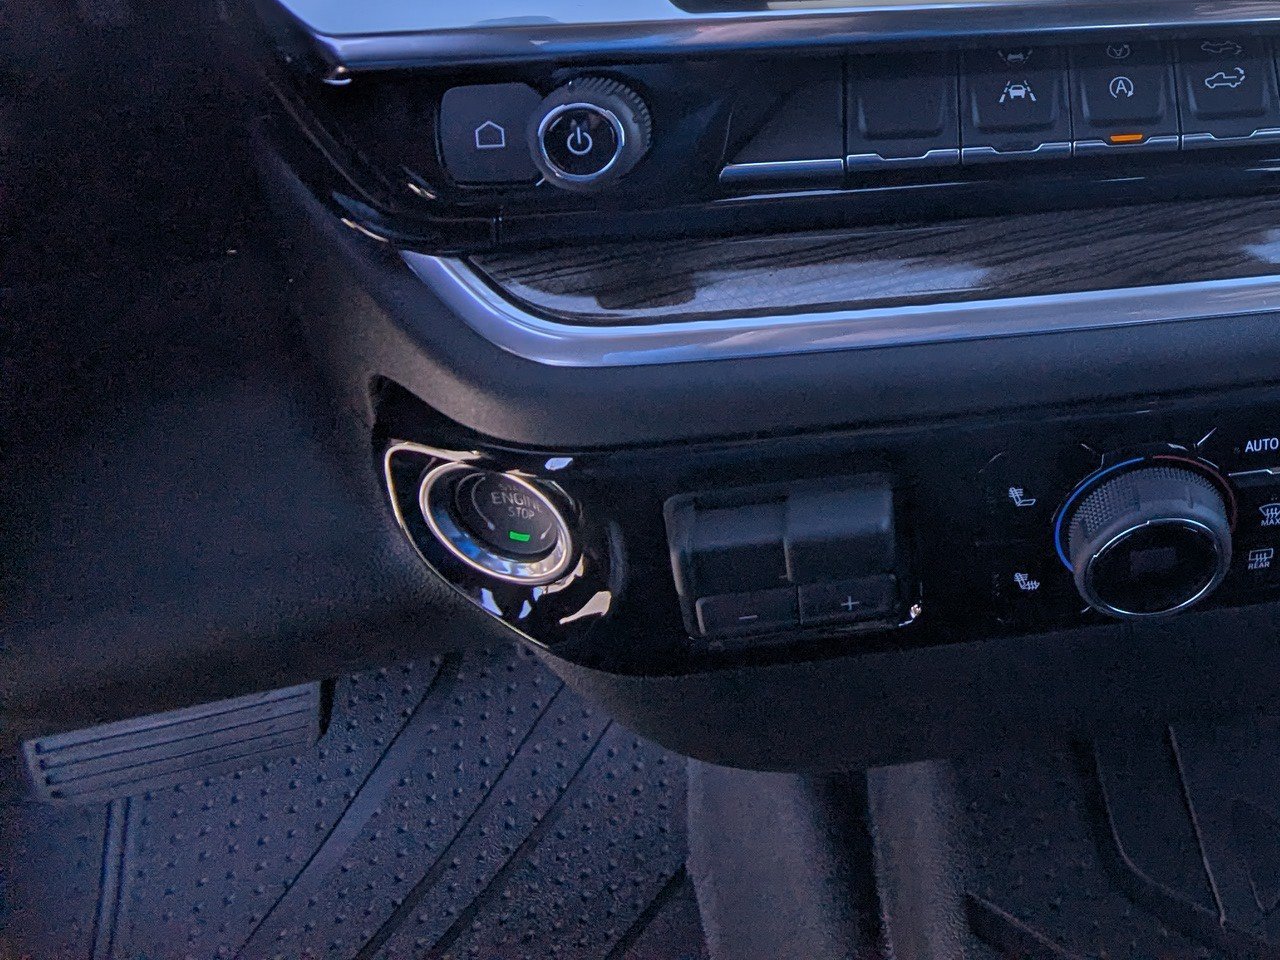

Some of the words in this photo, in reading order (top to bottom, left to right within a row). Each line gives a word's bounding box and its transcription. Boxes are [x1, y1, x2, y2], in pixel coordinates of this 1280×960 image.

[1245, 437, 1280, 453] AUTO
[507, 505, 535, 520] STOP
[1247, 560, 1271, 571] REAR
